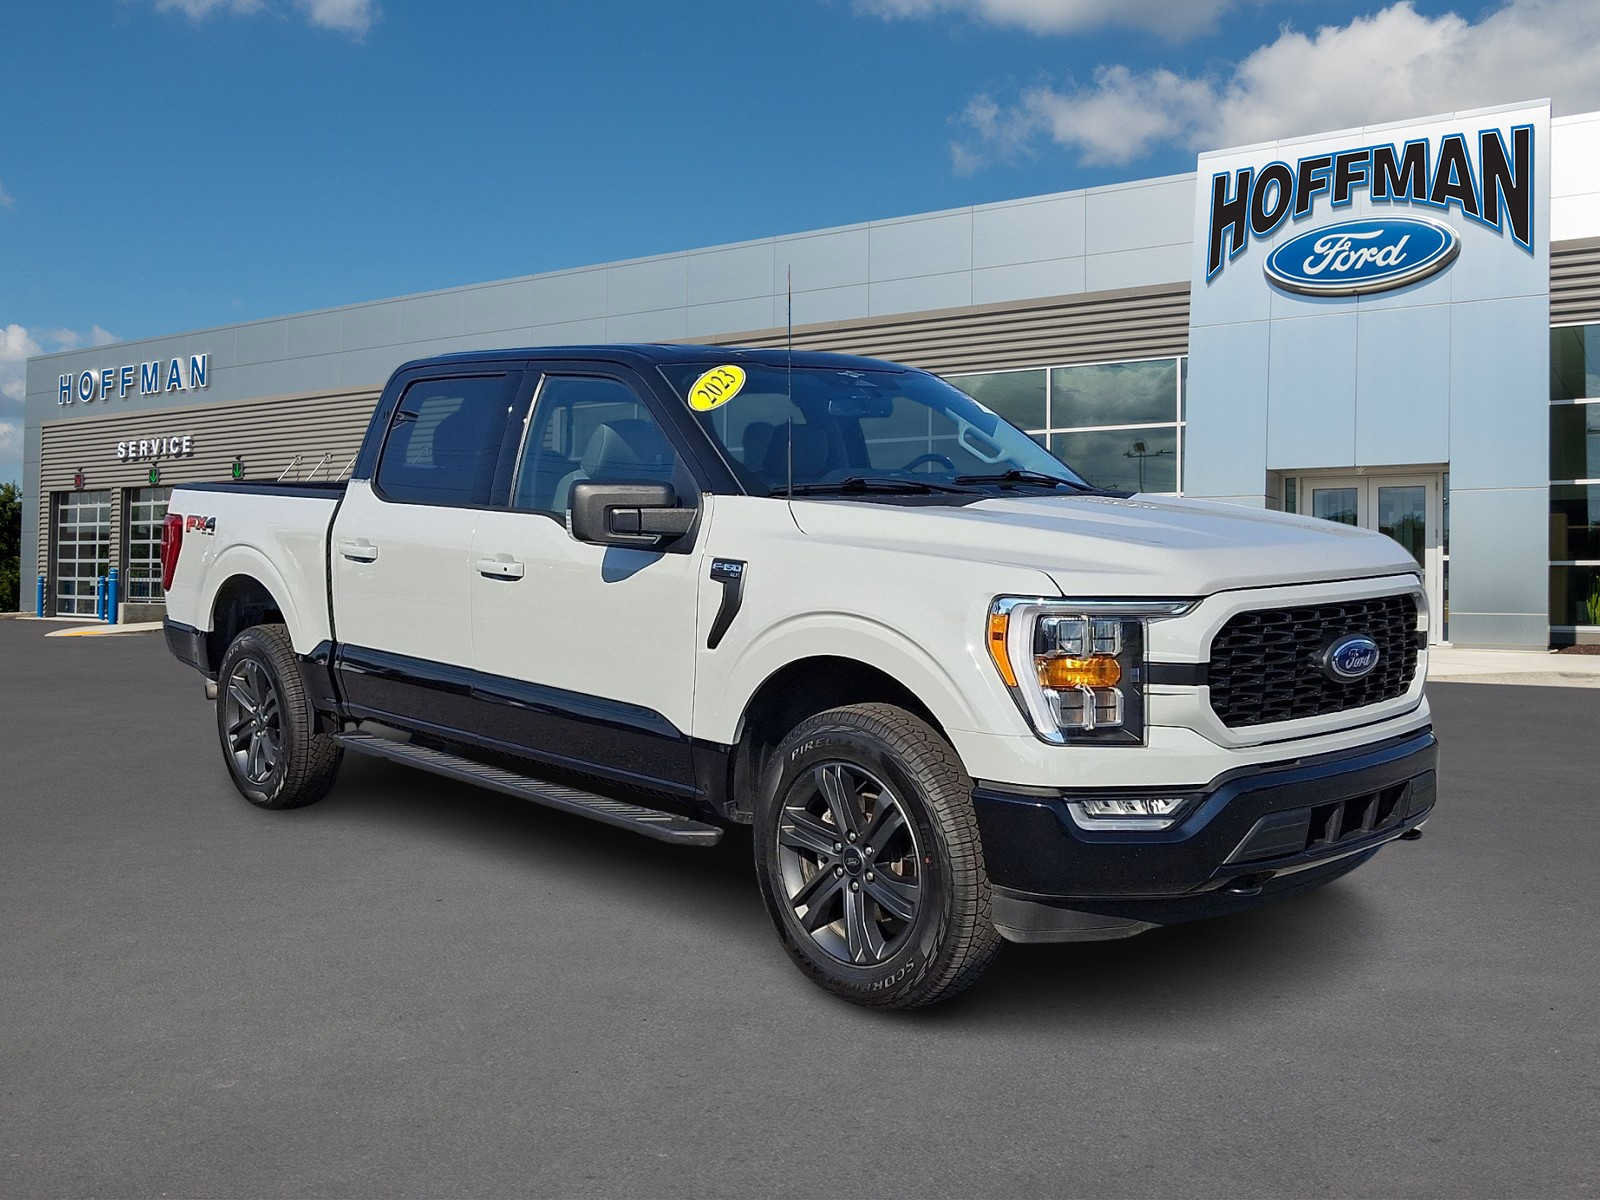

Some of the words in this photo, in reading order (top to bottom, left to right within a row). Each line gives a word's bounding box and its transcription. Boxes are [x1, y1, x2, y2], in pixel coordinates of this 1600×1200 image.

[1206, 124, 1534, 284] HOFFMAN
[1303, 229, 1408, 275] Ford
[58, 354, 208, 404] HOFFMAN
[697, 369, 735, 404] 2023
[117, 436, 193, 458] SERVICE
[185, 514, 216, 533] FX4
[1345, 648, 1371, 669] Ford
